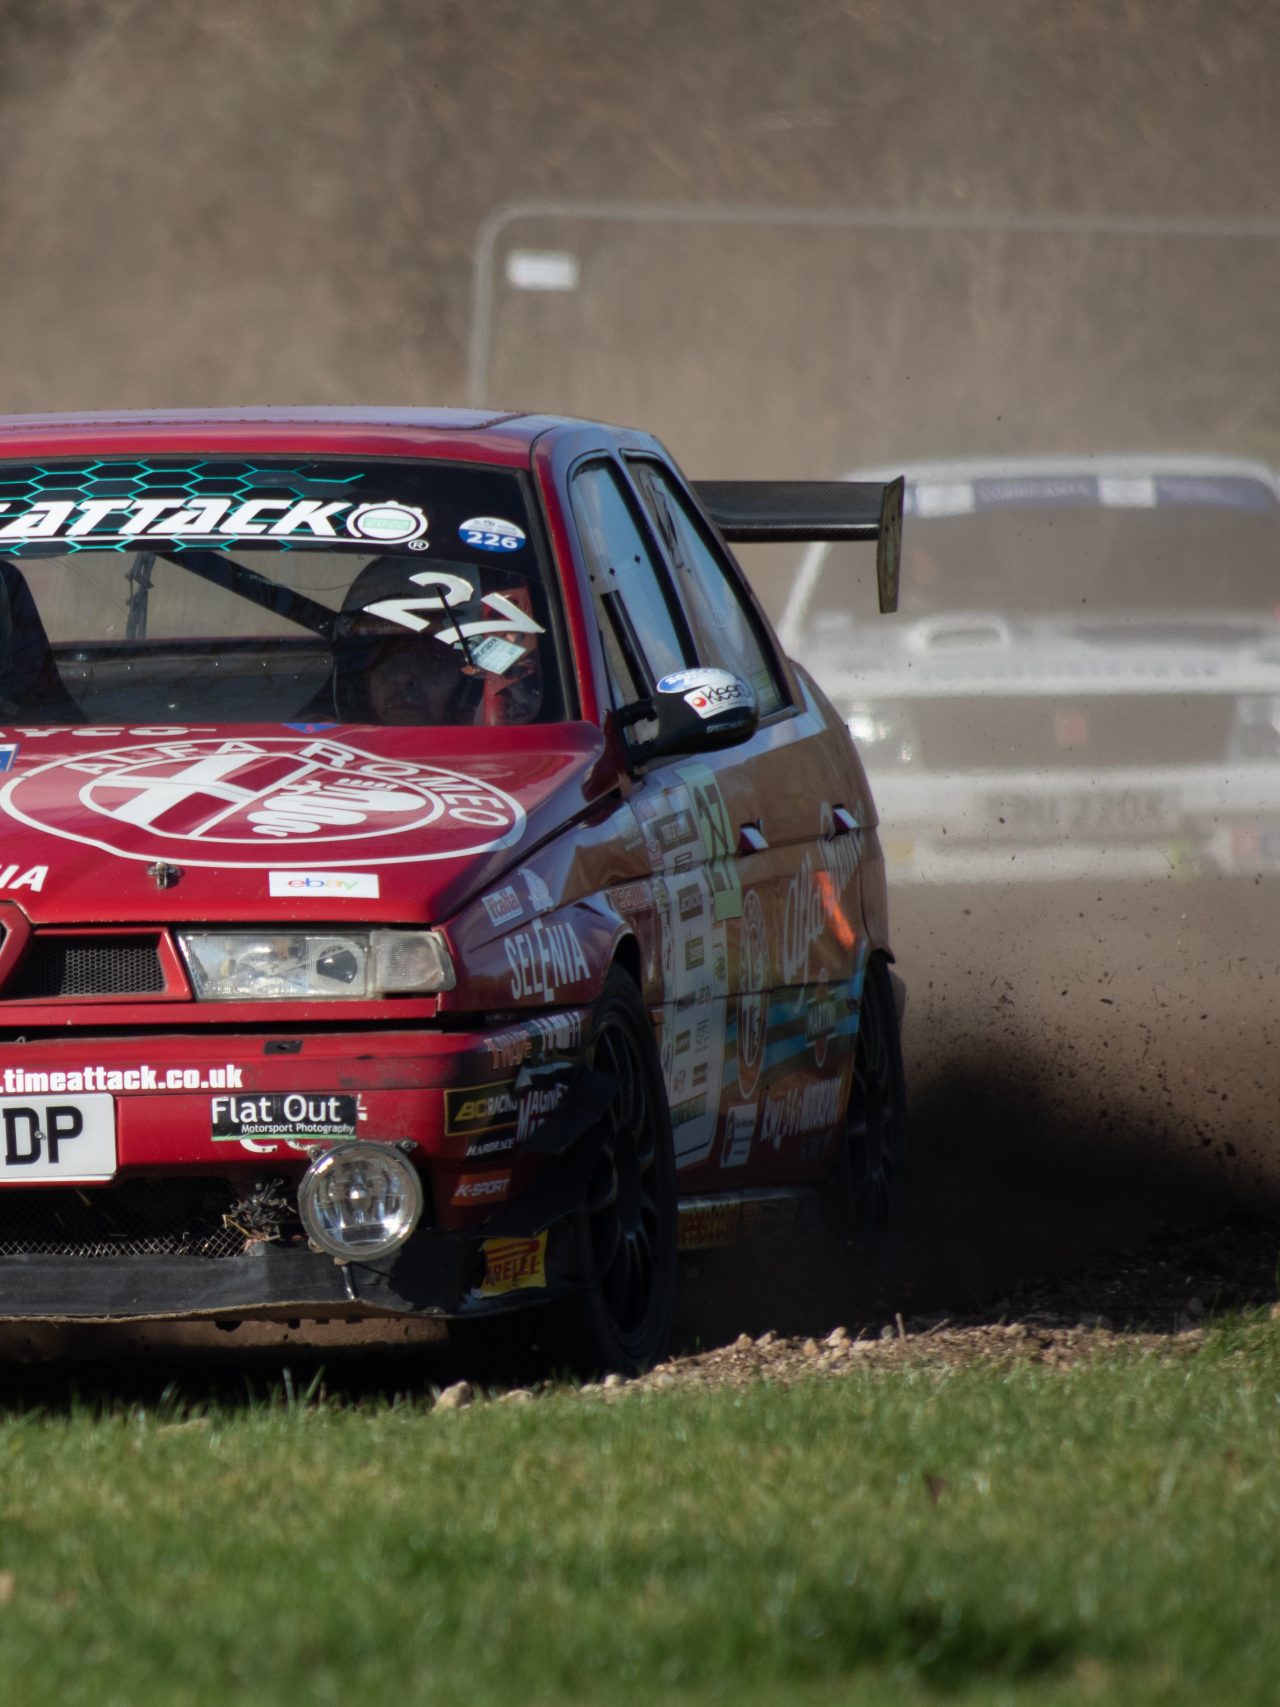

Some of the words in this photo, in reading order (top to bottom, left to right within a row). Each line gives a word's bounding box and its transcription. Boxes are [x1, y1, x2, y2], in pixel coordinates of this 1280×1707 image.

[466, 531, 518, 549] 226
[62, 740, 267, 775] ALFA
[299, 742, 510, 826] ROMEO
[287, 876, 360, 891] ebay
[504, 918, 591, 1003] SELENIA
[212, 1096, 272, 1124] Flat
[283, 1095, 341, 1122] Out
[241, 1123, 293, 1133] Motorsport
[295, 1123, 355, 1135] Photography
[454, 1178, 511, 1198] K-SPORT
